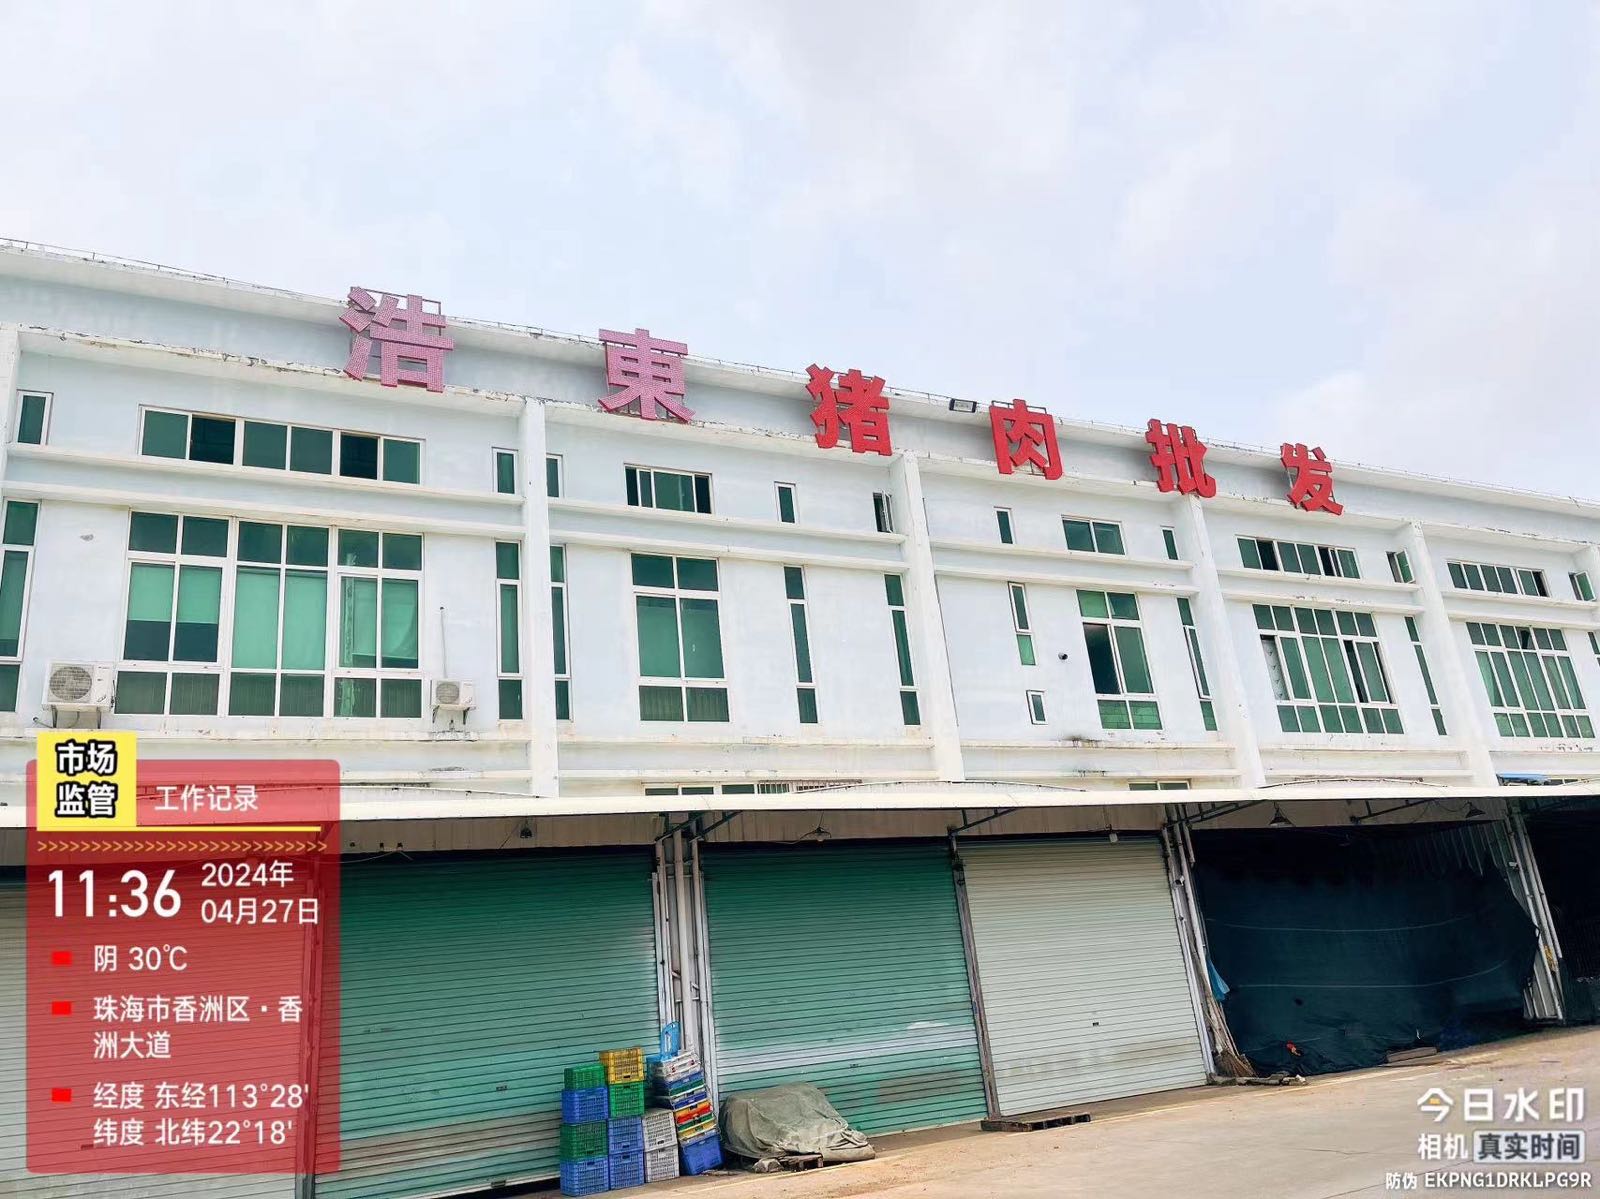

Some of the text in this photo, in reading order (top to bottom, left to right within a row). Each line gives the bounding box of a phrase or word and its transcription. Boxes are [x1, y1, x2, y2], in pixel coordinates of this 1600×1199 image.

[339, 286, 1343, 515] 浩東猪肉批发
